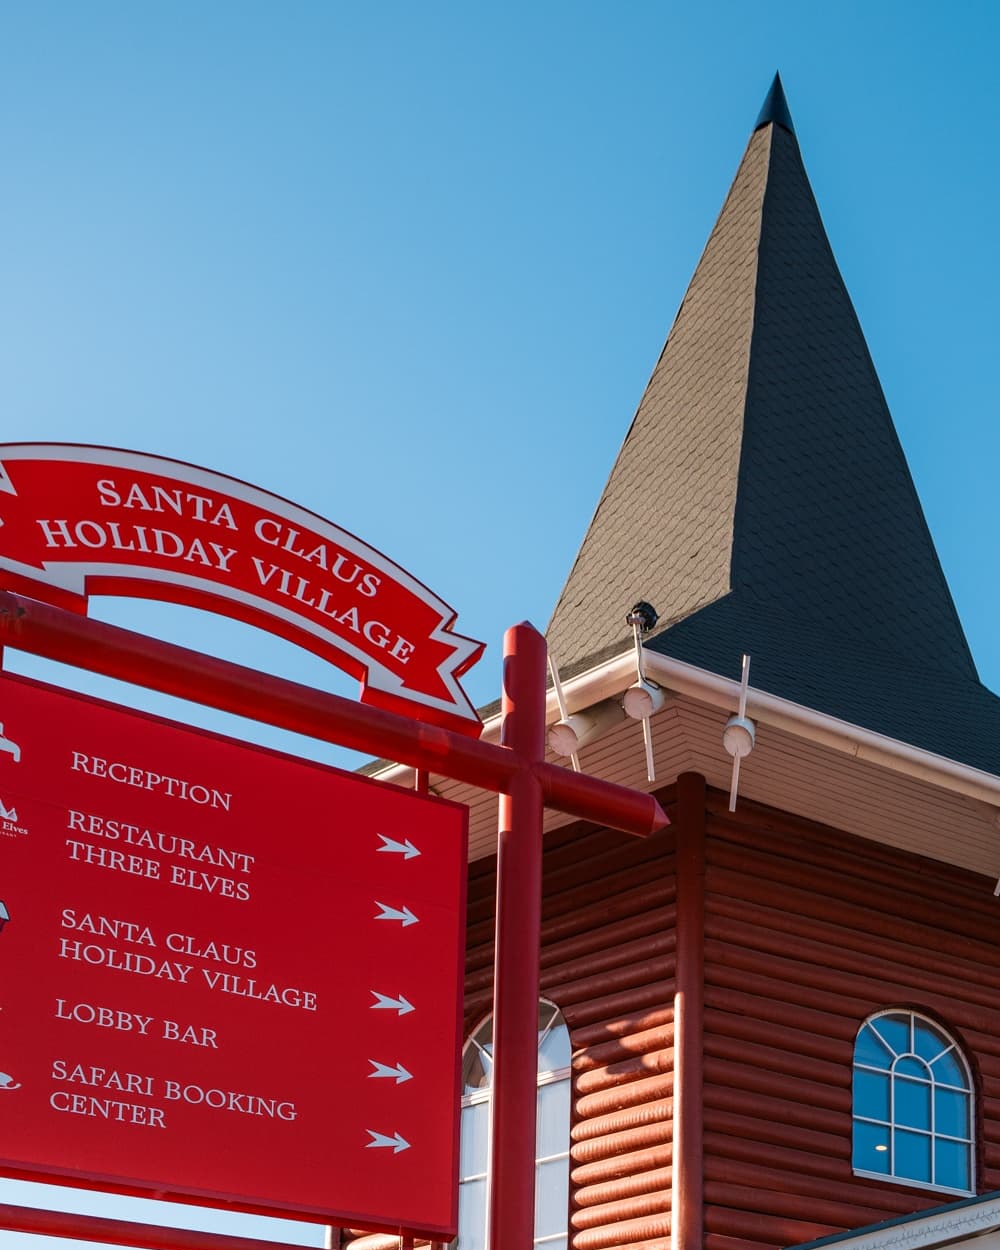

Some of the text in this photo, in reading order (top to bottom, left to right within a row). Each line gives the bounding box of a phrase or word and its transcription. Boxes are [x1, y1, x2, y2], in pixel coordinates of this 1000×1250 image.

[96, 479, 382, 598] SANTA CLAUS
[36, 519, 415, 664] HOLIDAY VILLAGE
[70, 750, 232, 811] RECEPTION
[65, 839, 250, 901] THREE ELVES
[67, 809, 255, 873] RESTAURANT
[61, 908, 257, 969] SANTA CLAUS
[58, 937, 317, 1012] HOLIDAY VILLAGE
[55, 999, 218, 1049] LOBBY BAR
[49, 1091, 167, 1129] CENTER
[52, 1060, 298, 1122] SAFARI BOOKING
